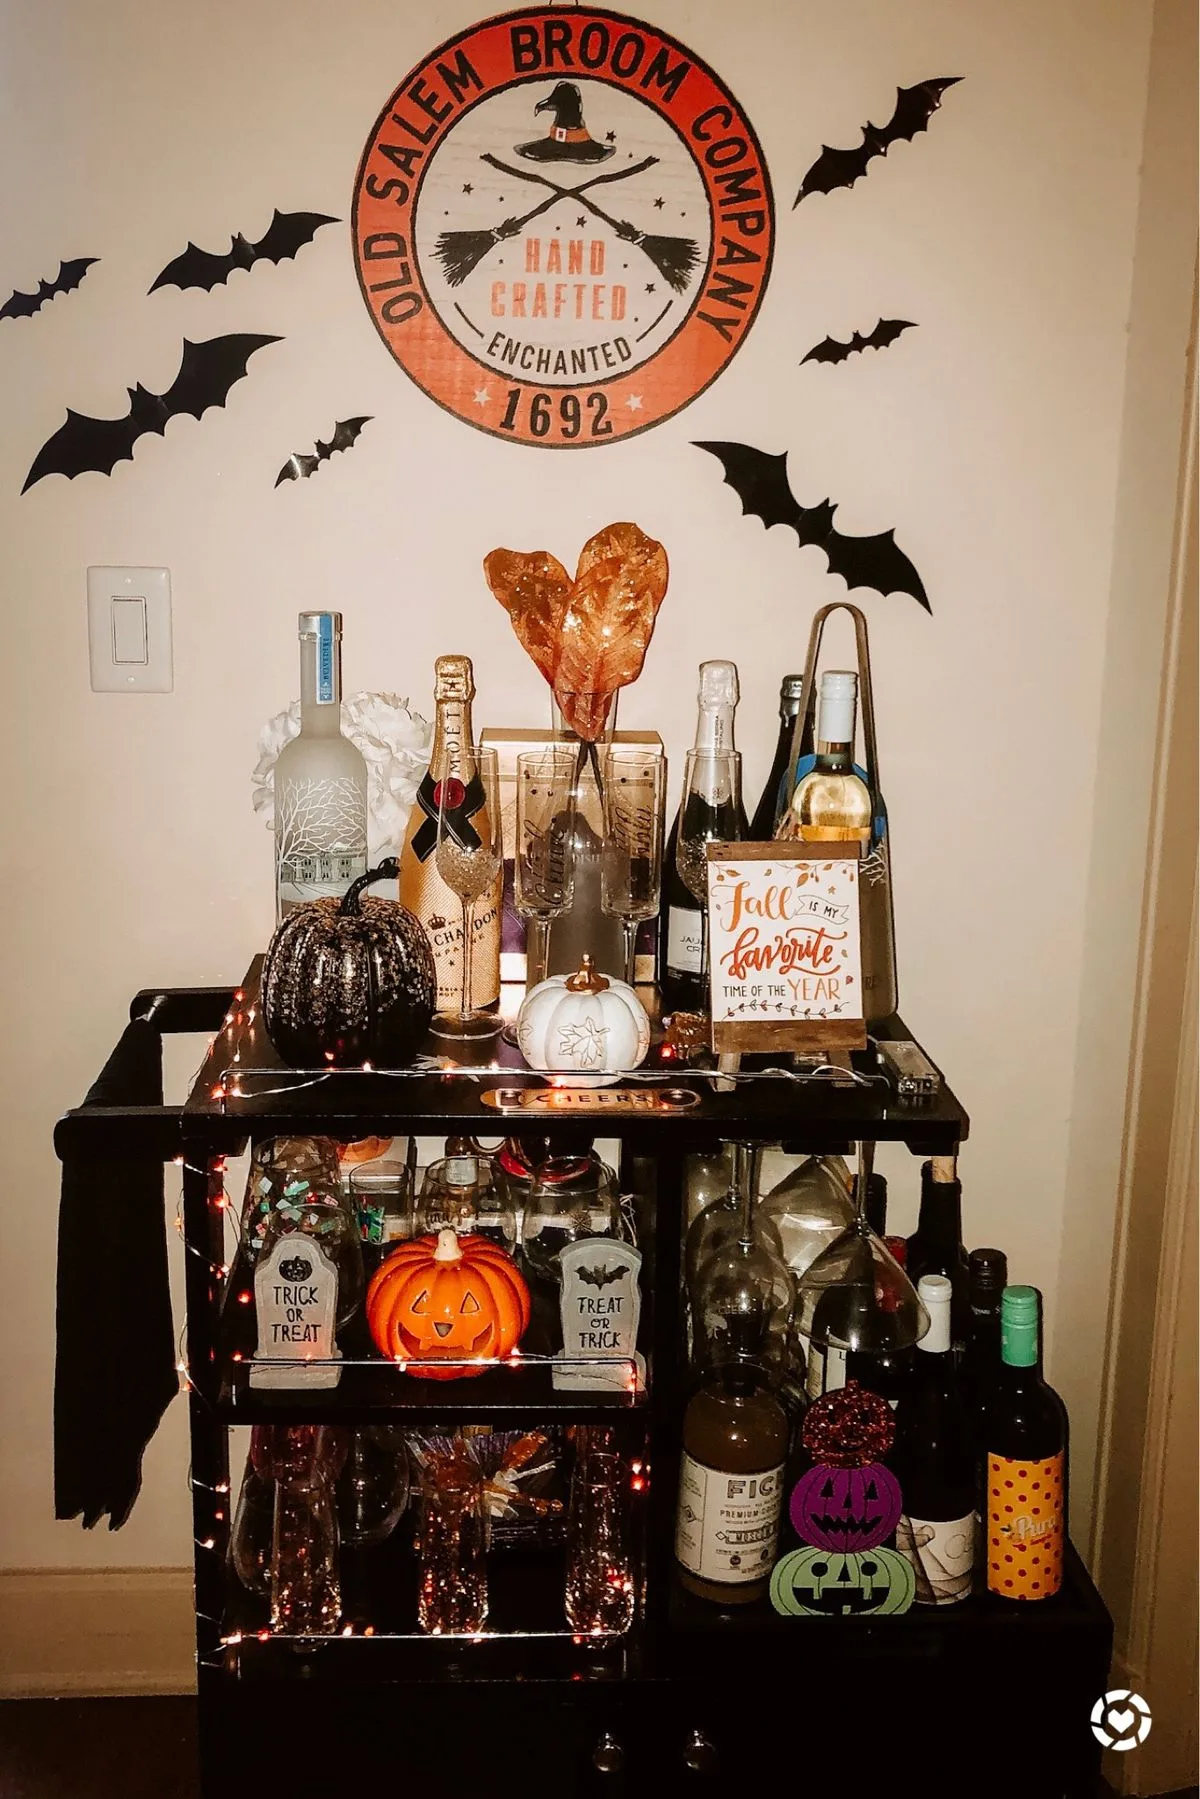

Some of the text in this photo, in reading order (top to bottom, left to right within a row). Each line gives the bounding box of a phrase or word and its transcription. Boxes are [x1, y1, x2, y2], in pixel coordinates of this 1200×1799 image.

[362, 20, 766, 345] OLD SALEM BROOM COMPANY
[524, 238, 606, 277] HAND
[490, 281, 627, 322] CRAFTED
[486, 331, 633, 376] ENCHANTED
[499, 387, 613, 439] 1692
[711, 881, 840, 932] Fall IS MY
[434, 907, 498, 946] CHADON
[720, 926, 848, 980] favorite
[722, 977, 841, 1001] TIME OF THE YEAR
[535, 1094, 649, 1103] CHEERS
[272, 1285, 319, 1306] TRICK
[577, 1296, 626, 1315] TREAT
[286, 1308, 305, 1323] OR
[590, 1316, 611, 1330] OR
[271, 1323, 322, 1344] TREAT
[578, 1330, 622, 1349] TRICK
[719, 1509, 759, 1519] PREMIUM
